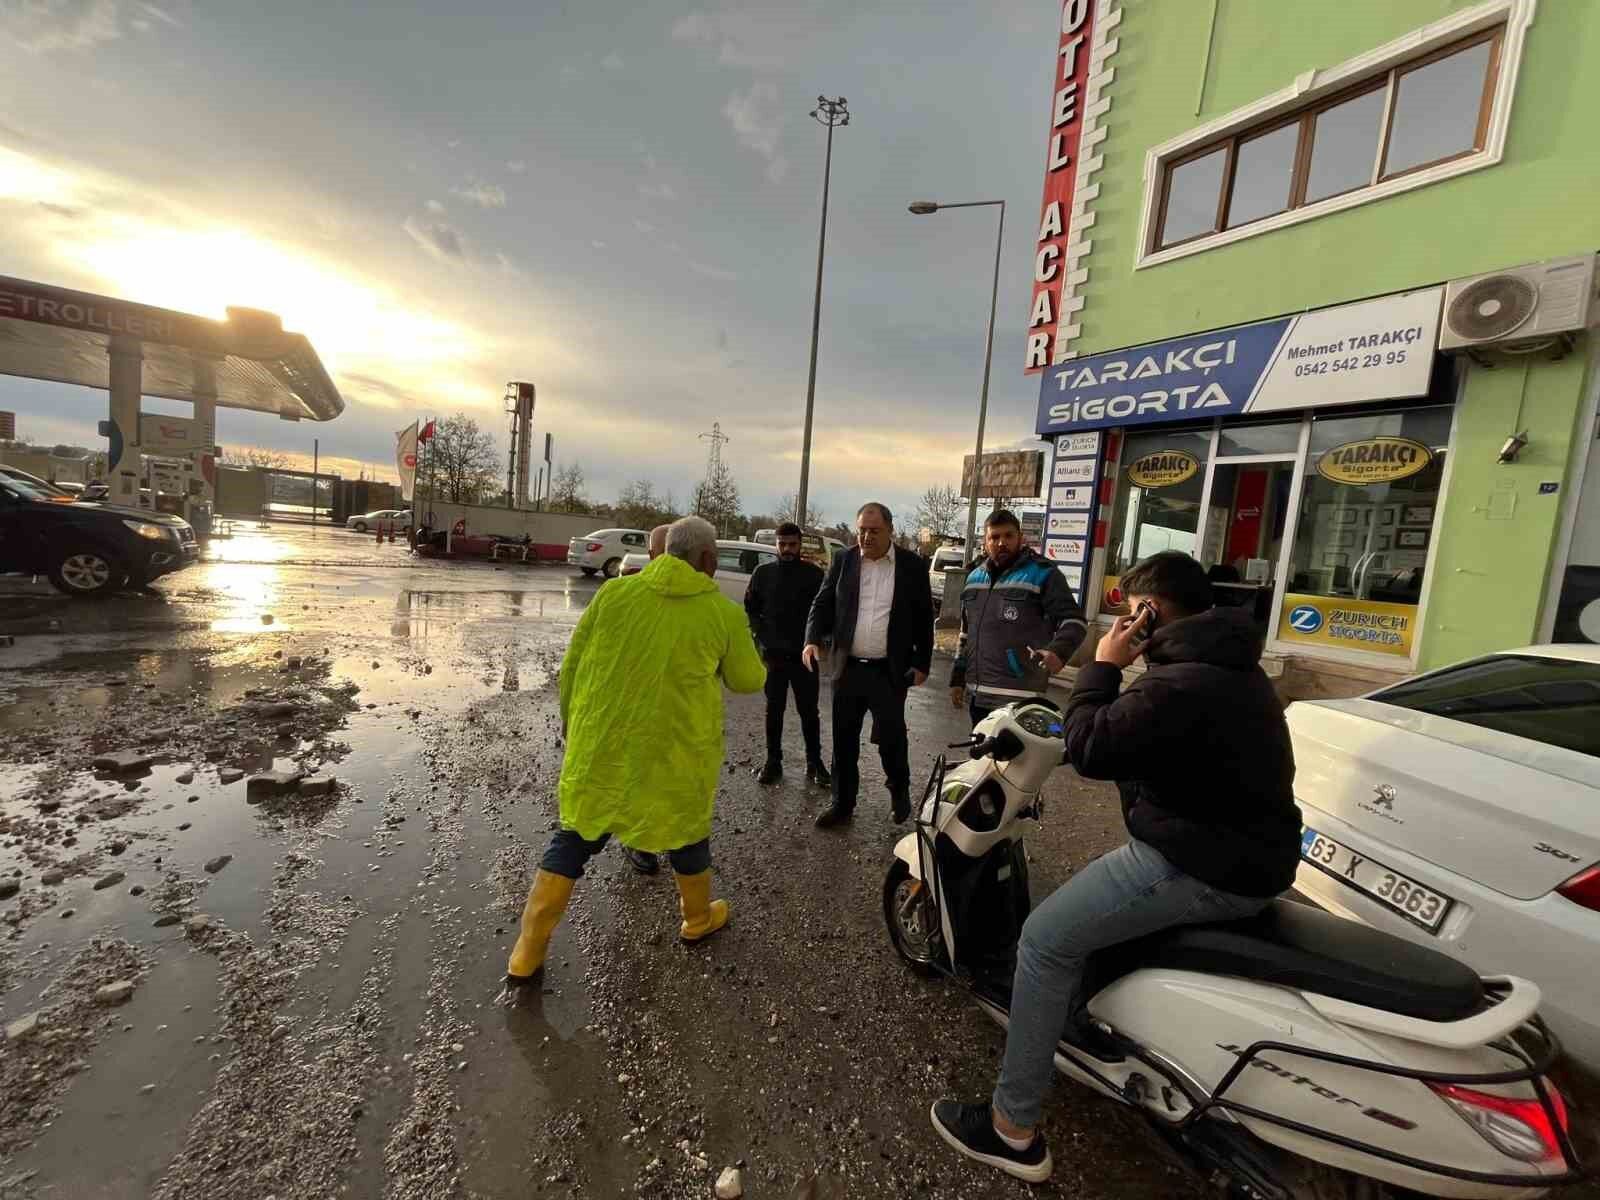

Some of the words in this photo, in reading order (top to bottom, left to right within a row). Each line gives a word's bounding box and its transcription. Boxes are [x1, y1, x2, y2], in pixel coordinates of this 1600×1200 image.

[1048, 0, 1088, 173] OTEL
[1025, 200, 1062, 368] ACAR
[1288, 340, 1344, 360] Mehmet
[1348, 326, 1422, 351] TARAKÇI
[1054, 339, 1237, 391] TARAKÇI
[1295, 361, 1328, 377] 0542
[1332, 357, 1359, 373] 542
[1363, 353, 1382, 369] 29
[1386, 350, 1407, 365] 95
[1047, 382, 1232, 426] SİGORTA
[1136, 455, 1190, 475] TARAKÇI
[1332, 443, 1417, 468] TARAKÇI
[1328, 608, 1409, 632] ZURICH
[1311, 837, 1337, 864] 63
[1344, 855, 1364, 879] X
[1377, 873, 1442, 922] 3663
